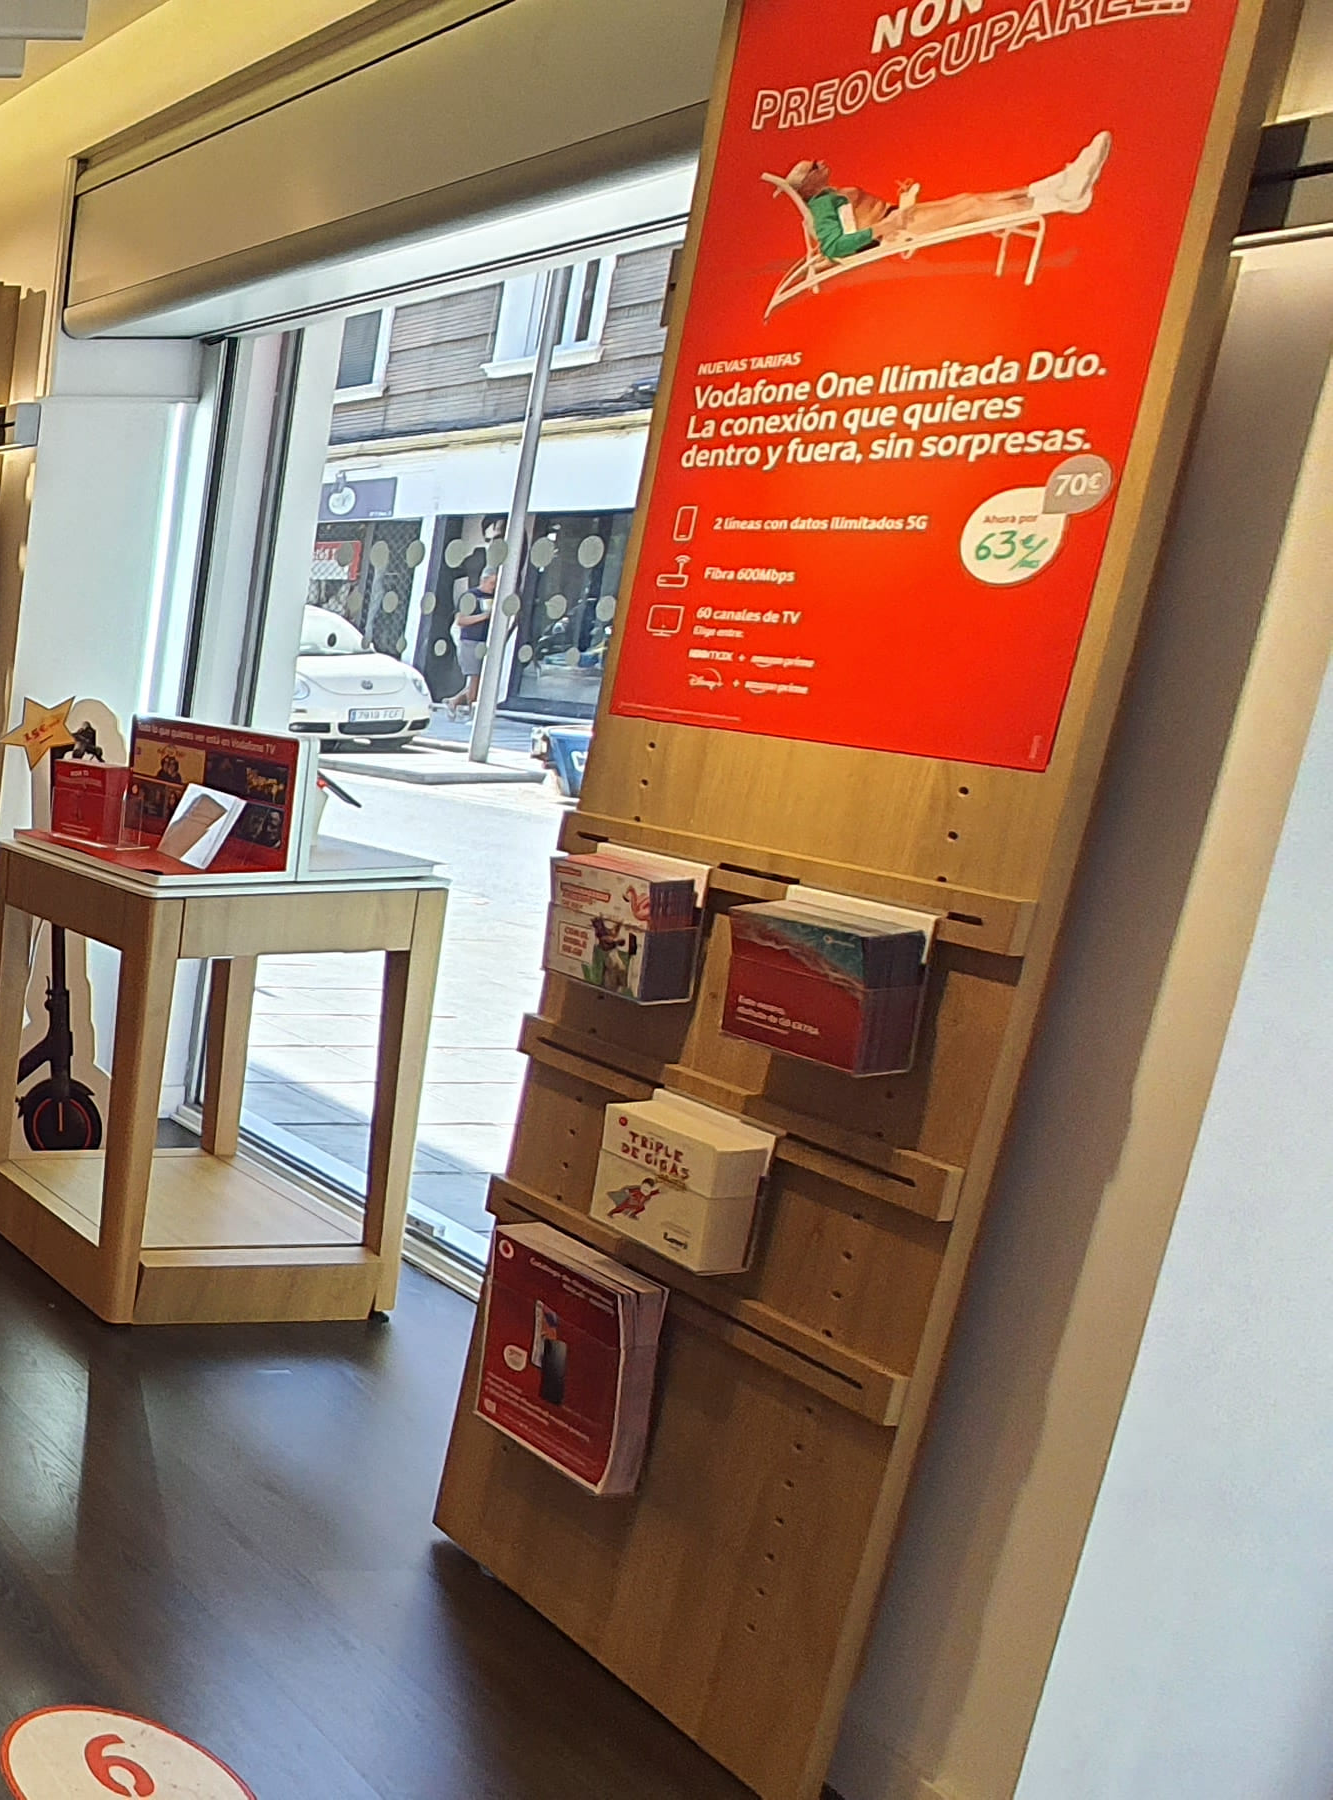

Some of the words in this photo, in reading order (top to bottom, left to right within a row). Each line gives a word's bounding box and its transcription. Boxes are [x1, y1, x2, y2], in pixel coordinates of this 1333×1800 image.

[871, 0, 984, 53] NON
[697, 359, 747, 375] NUEVAS
[750, 352, 802, 369] TARIFAS
[695, 379, 811, 410] Vodafone
[816, 372, 874, 399] One
[879, 355, 1020, 394] Ilimitada
[1026, 346, 1108, 381] Dúo.
[686, 415, 716, 439] La
[720, 404, 837, 437] conexión
[843, 404, 899, 435] que
[903, 395, 1025, 431] quieres
[681, 443, 761, 468] dentro
[762, 445, 783, 471] y
[786, 437, 863, 464] fuera,
[869, 432, 915, 460] sin
[920, 427, 1092, 463] sorpresas.
[1054, 472, 1102, 497] 70€
[713, 517, 723, 530] 2
[724, 515, 762, 530] líneas
[764, 517, 789, 530] con
[790, 516, 828, 530] datos
[906, 515, 928, 530] 5G
[983, 514, 1017, 524] Ahora
[1018, 514, 1038, 525] por
[704, 566, 735, 580] Fibra
[737, 567, 795, 584] 600Mbps
[696, 606, 712, 619] 60
[713, 608, 761, 622] canales
[762, 609, 780, 622] de
[782, 611, 801, 624] TV
[621, 1143, 640, 1159] DE
[85, 1734, 155, 1797] 6
